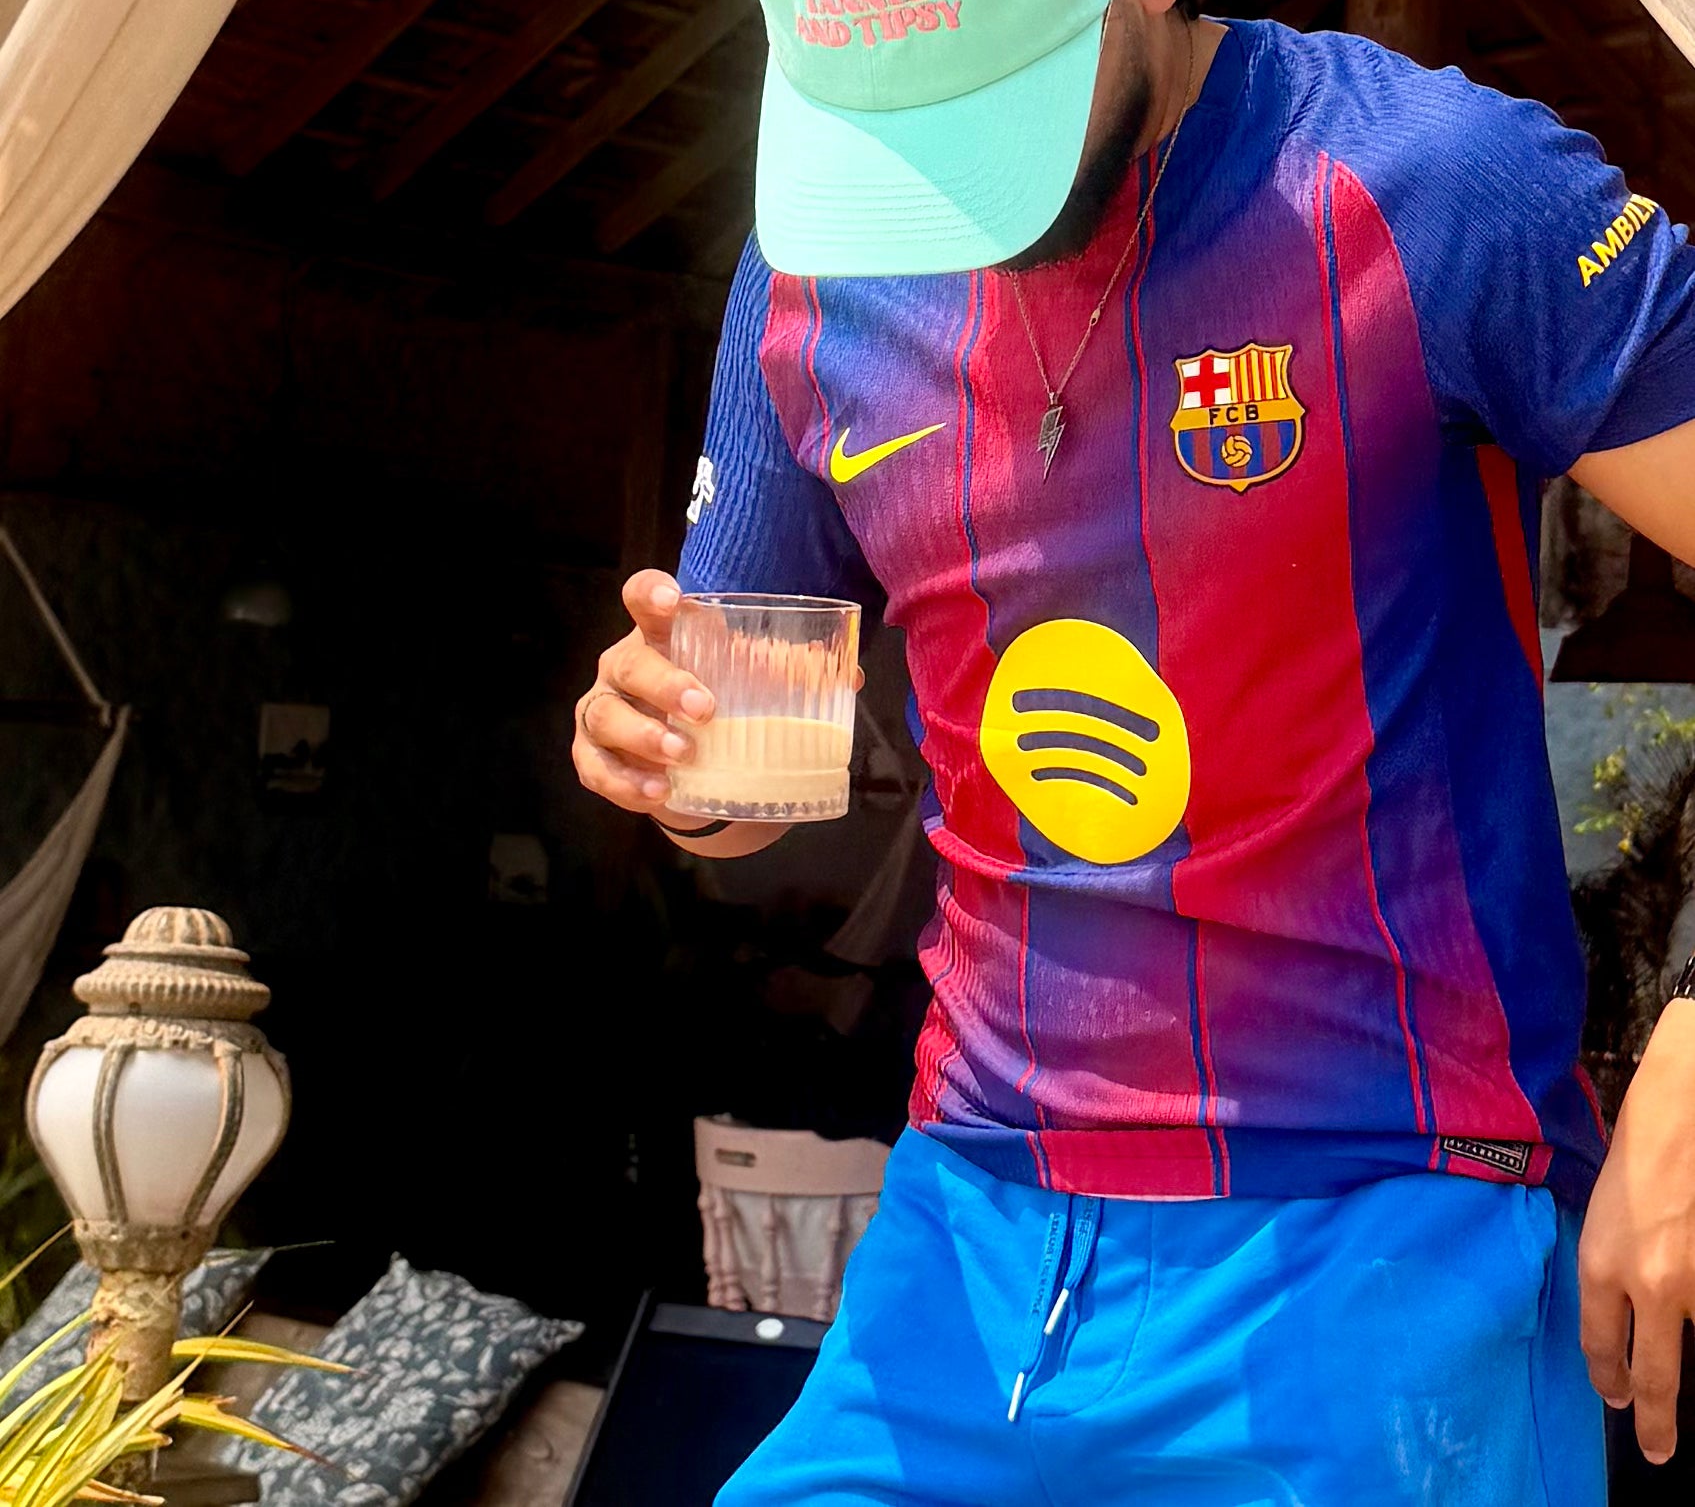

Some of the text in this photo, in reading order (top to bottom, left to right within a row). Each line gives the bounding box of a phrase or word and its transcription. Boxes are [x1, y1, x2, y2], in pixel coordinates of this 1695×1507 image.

[797, 0, 961, 48] AND TIPSY
[1208, 404, 1259, 425] FCB
